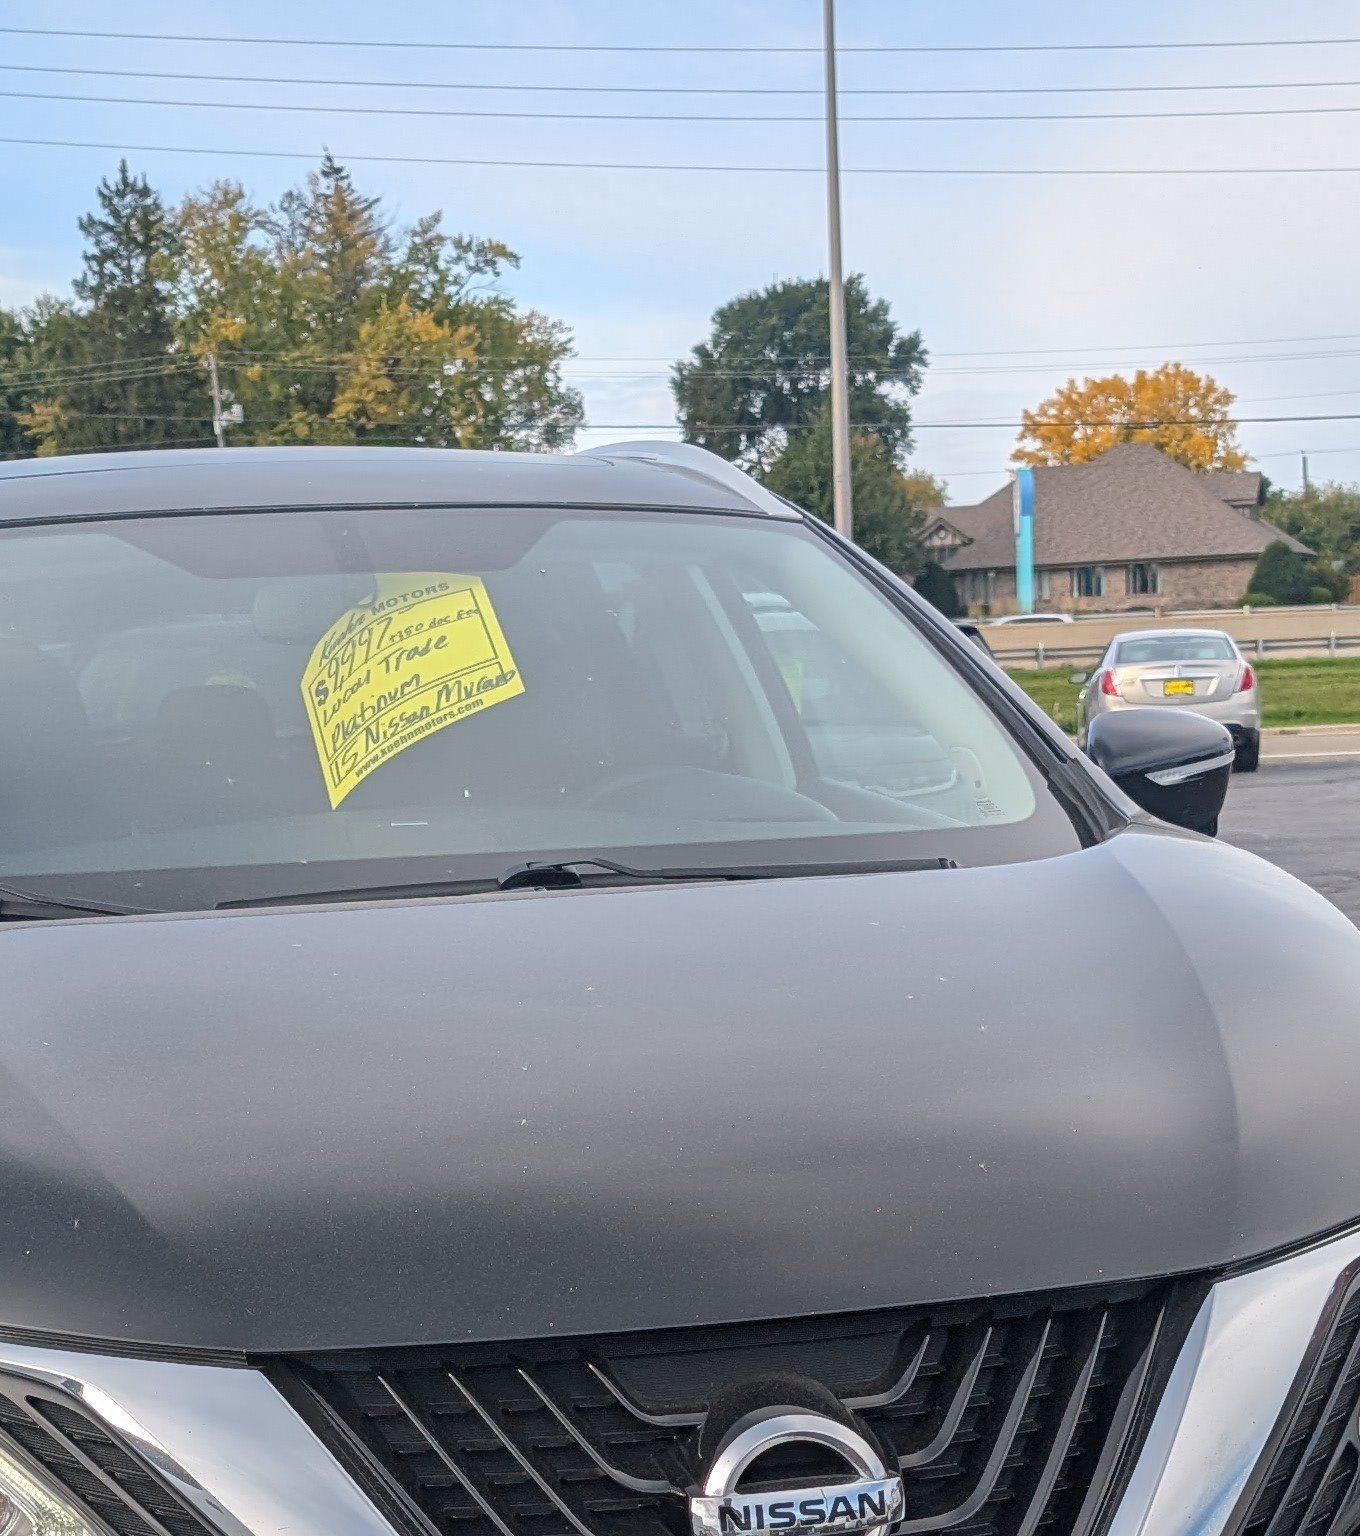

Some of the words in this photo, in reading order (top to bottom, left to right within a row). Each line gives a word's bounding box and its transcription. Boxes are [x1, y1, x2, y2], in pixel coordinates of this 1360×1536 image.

[371, 582, 450, 616] MOTORS
[377, 635, 449, 674] Trade
[354, 697, 484, 778] www.kuehnmotors.com
[364, 705, 430, 753] Nissan
[718, 1489, 886, 1531] NISSAN
